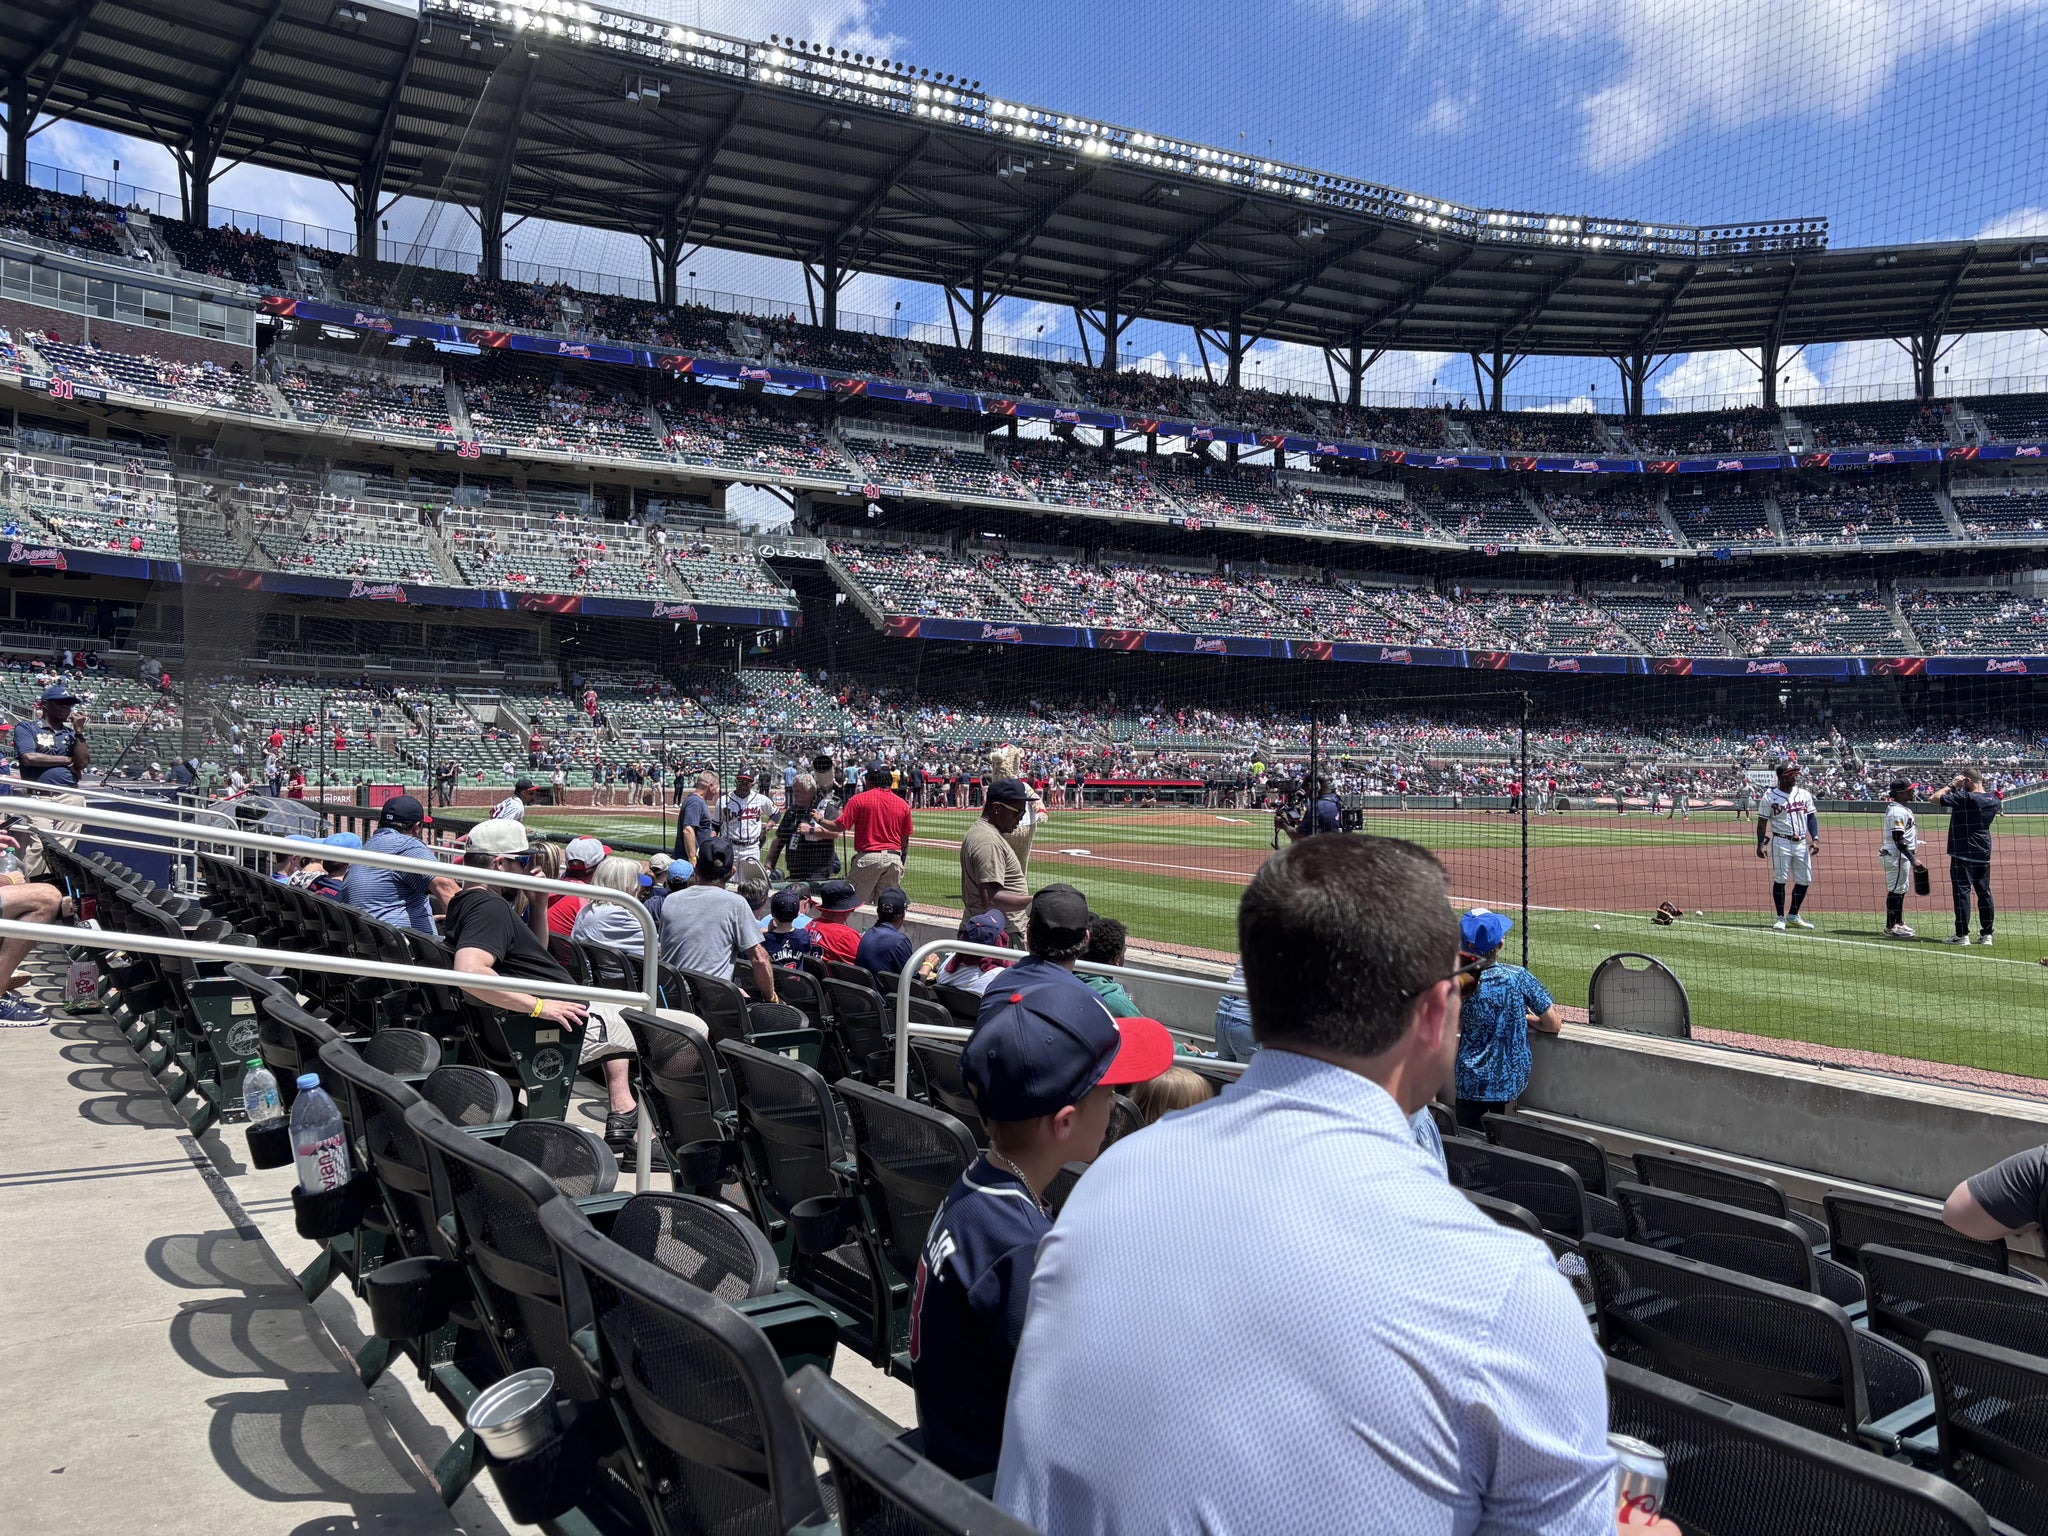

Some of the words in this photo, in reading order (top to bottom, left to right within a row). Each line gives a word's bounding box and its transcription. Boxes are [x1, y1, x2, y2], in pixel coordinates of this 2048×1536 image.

[29, 379, 47, 389] GREG
[49, 377, 73, 400] 31
[457, 440, 481, 459] 35
[863, 483, 880, 499] 41
[1184, 516, 1201, 531] 44
[8, 542, 58, 562] Braves
[776, 548, 822, 559] LEXUS
[1483, 543, 1500, 556] 47
[1713, 547, 1731, 560] 42
[350, 580, 397, 598] Braves
[333, 795, 351, 803] PARK
[243, 1002, 249, 1010] 5
